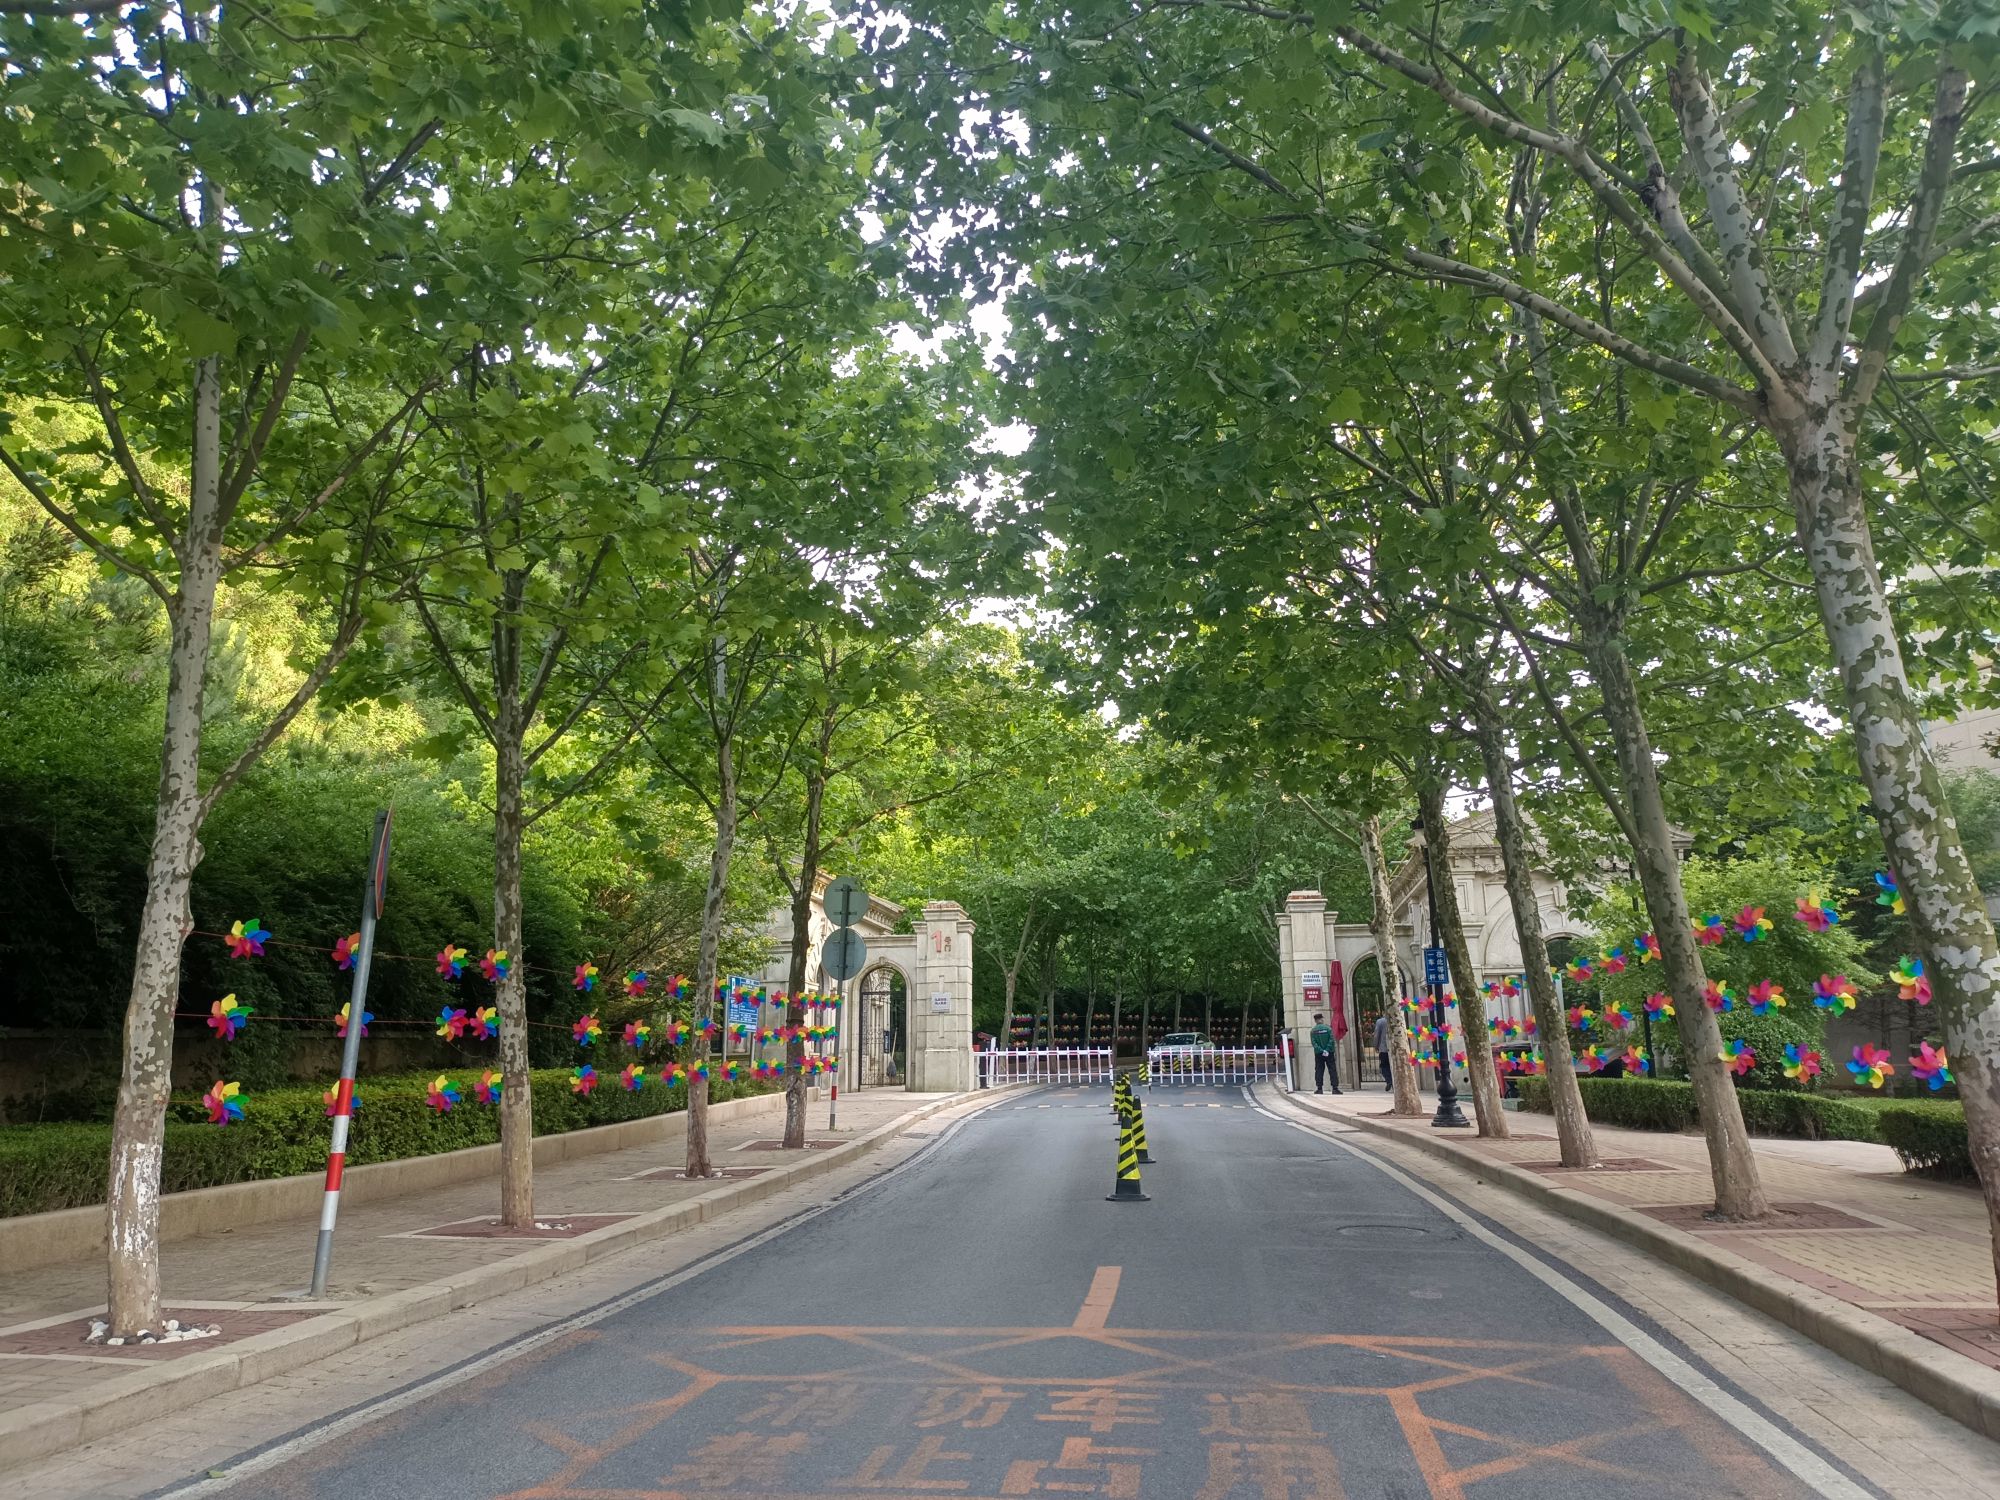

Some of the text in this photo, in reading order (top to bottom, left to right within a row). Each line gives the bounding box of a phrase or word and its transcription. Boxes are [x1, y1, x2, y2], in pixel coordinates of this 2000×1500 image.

[1436, 951, 1445, 981] 在此等候
[737, 1381, 1326, 1439] 消防车道
[659, 1430, 1348, 1500] 禁止占用
